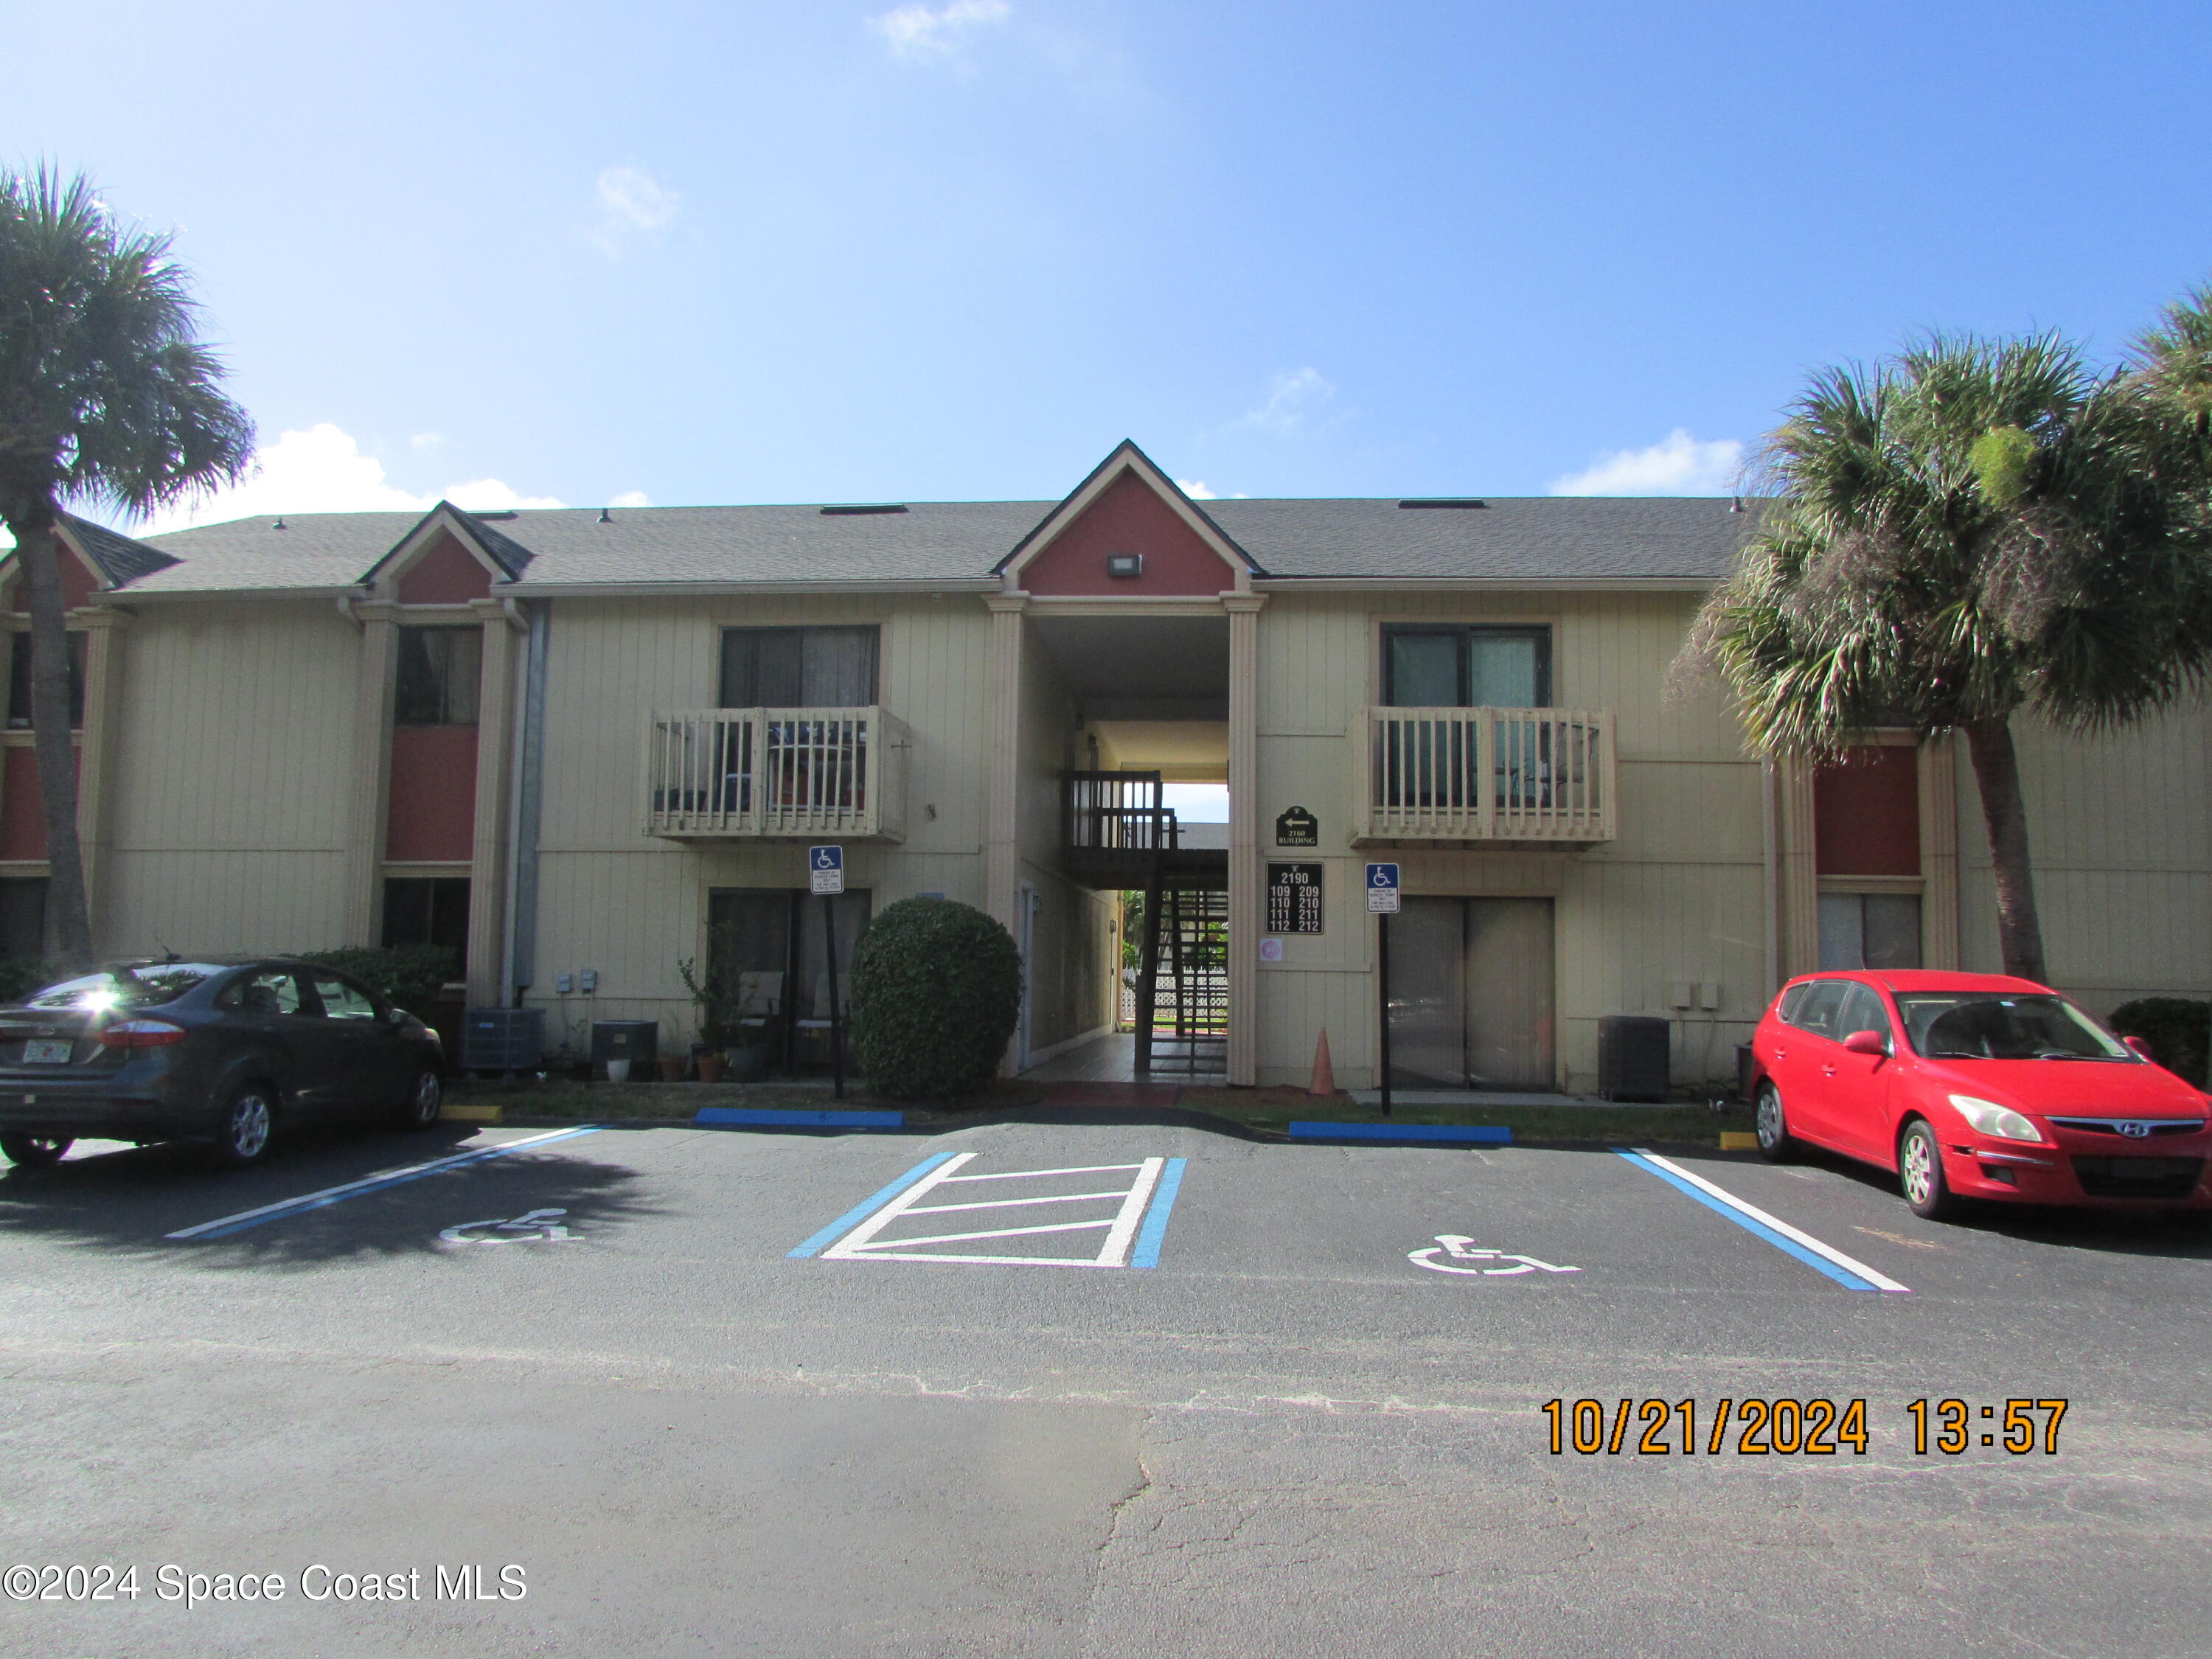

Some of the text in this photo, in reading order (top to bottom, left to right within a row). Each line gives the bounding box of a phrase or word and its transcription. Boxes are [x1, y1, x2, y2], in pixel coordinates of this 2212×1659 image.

[1281, 872, 1309, 884] 2190
[1270, 886, 1319, 897] 109 209
[1270, 897, 1319, 908] 110 210
[1270, 909, 1318, 919] 111 211
[1270, 920, 1318, 931] 112 212
